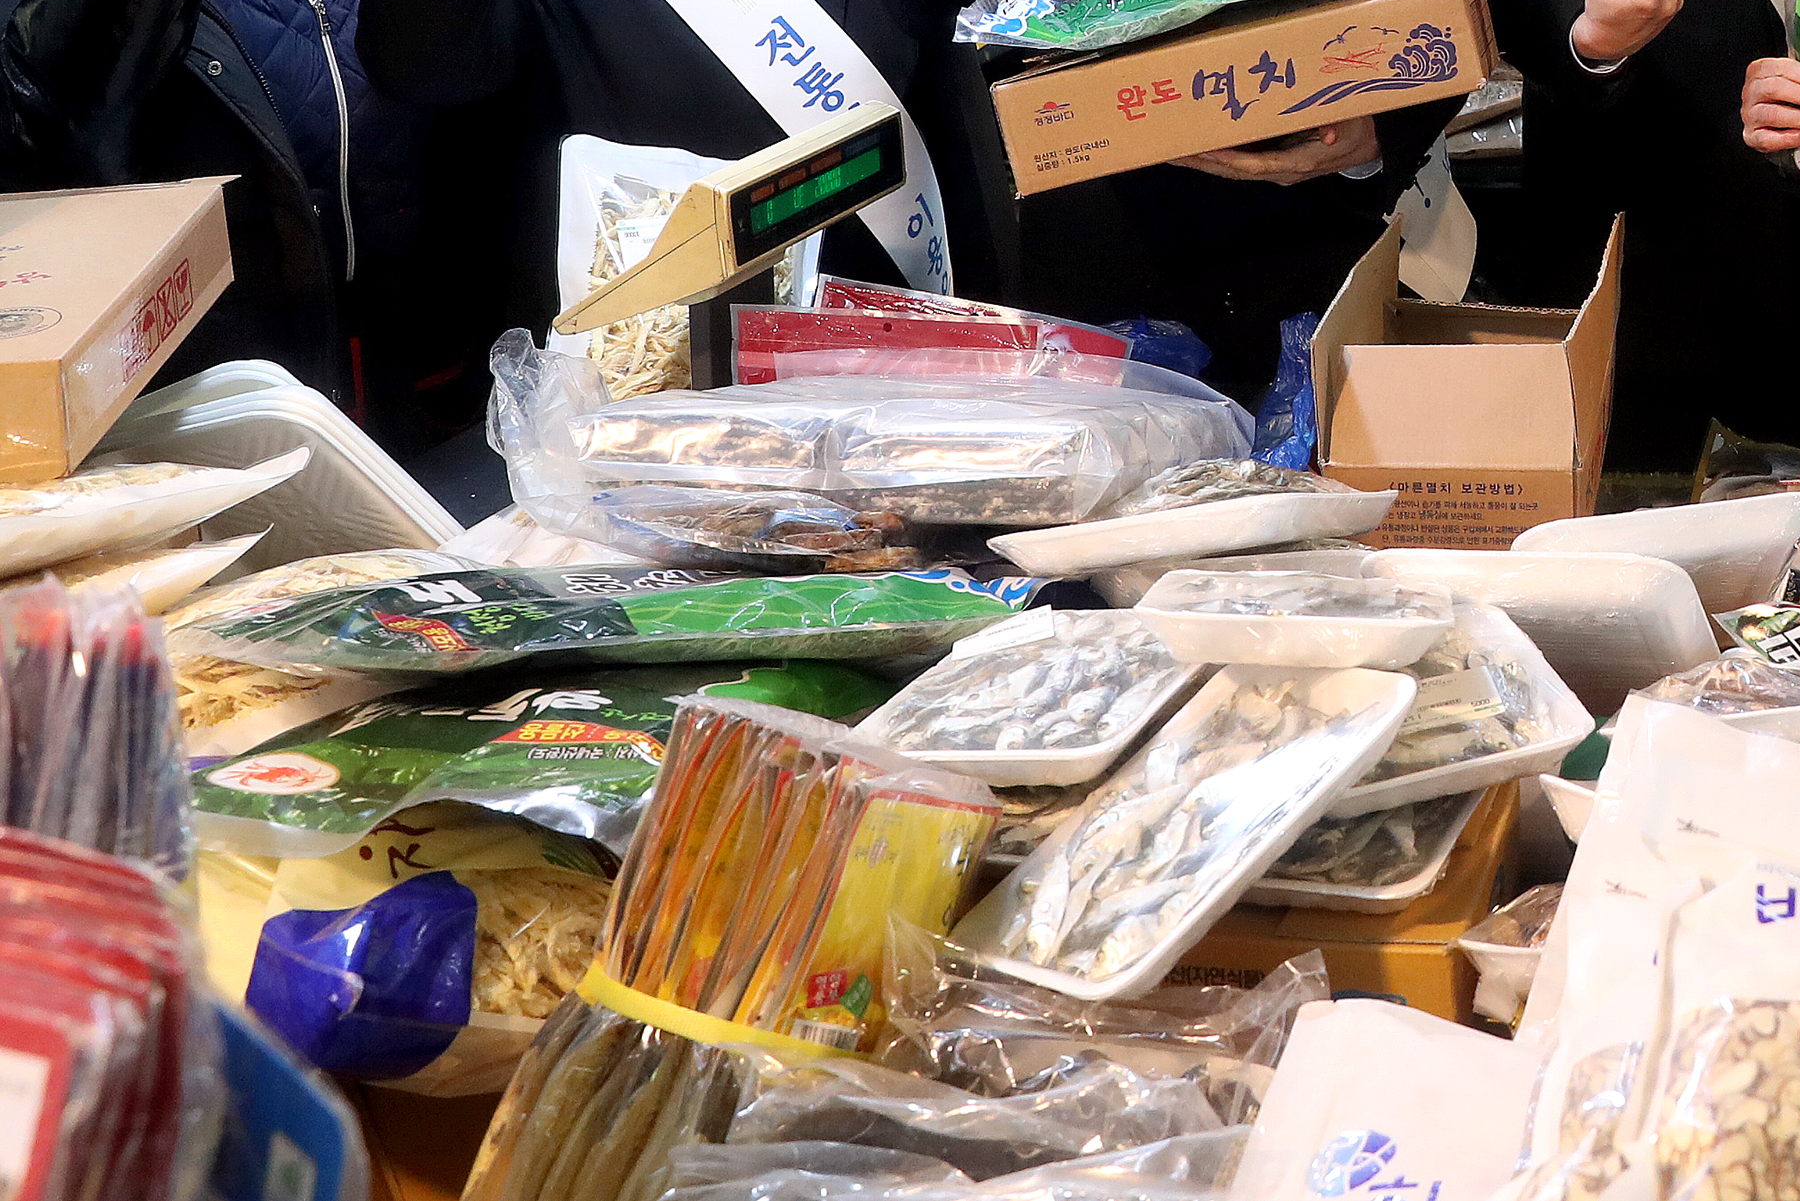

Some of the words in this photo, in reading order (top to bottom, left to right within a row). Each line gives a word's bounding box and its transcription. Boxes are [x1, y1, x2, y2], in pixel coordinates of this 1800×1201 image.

[1116, 78, 1182, 123] 완도
[1191, 49, 1299, 123] 멸치
[1066, 152, 1092, 168] 1.5kg
[516, 721, 587, 743] 선물용
[526, 746, 605, 761] 국내산(완도)
